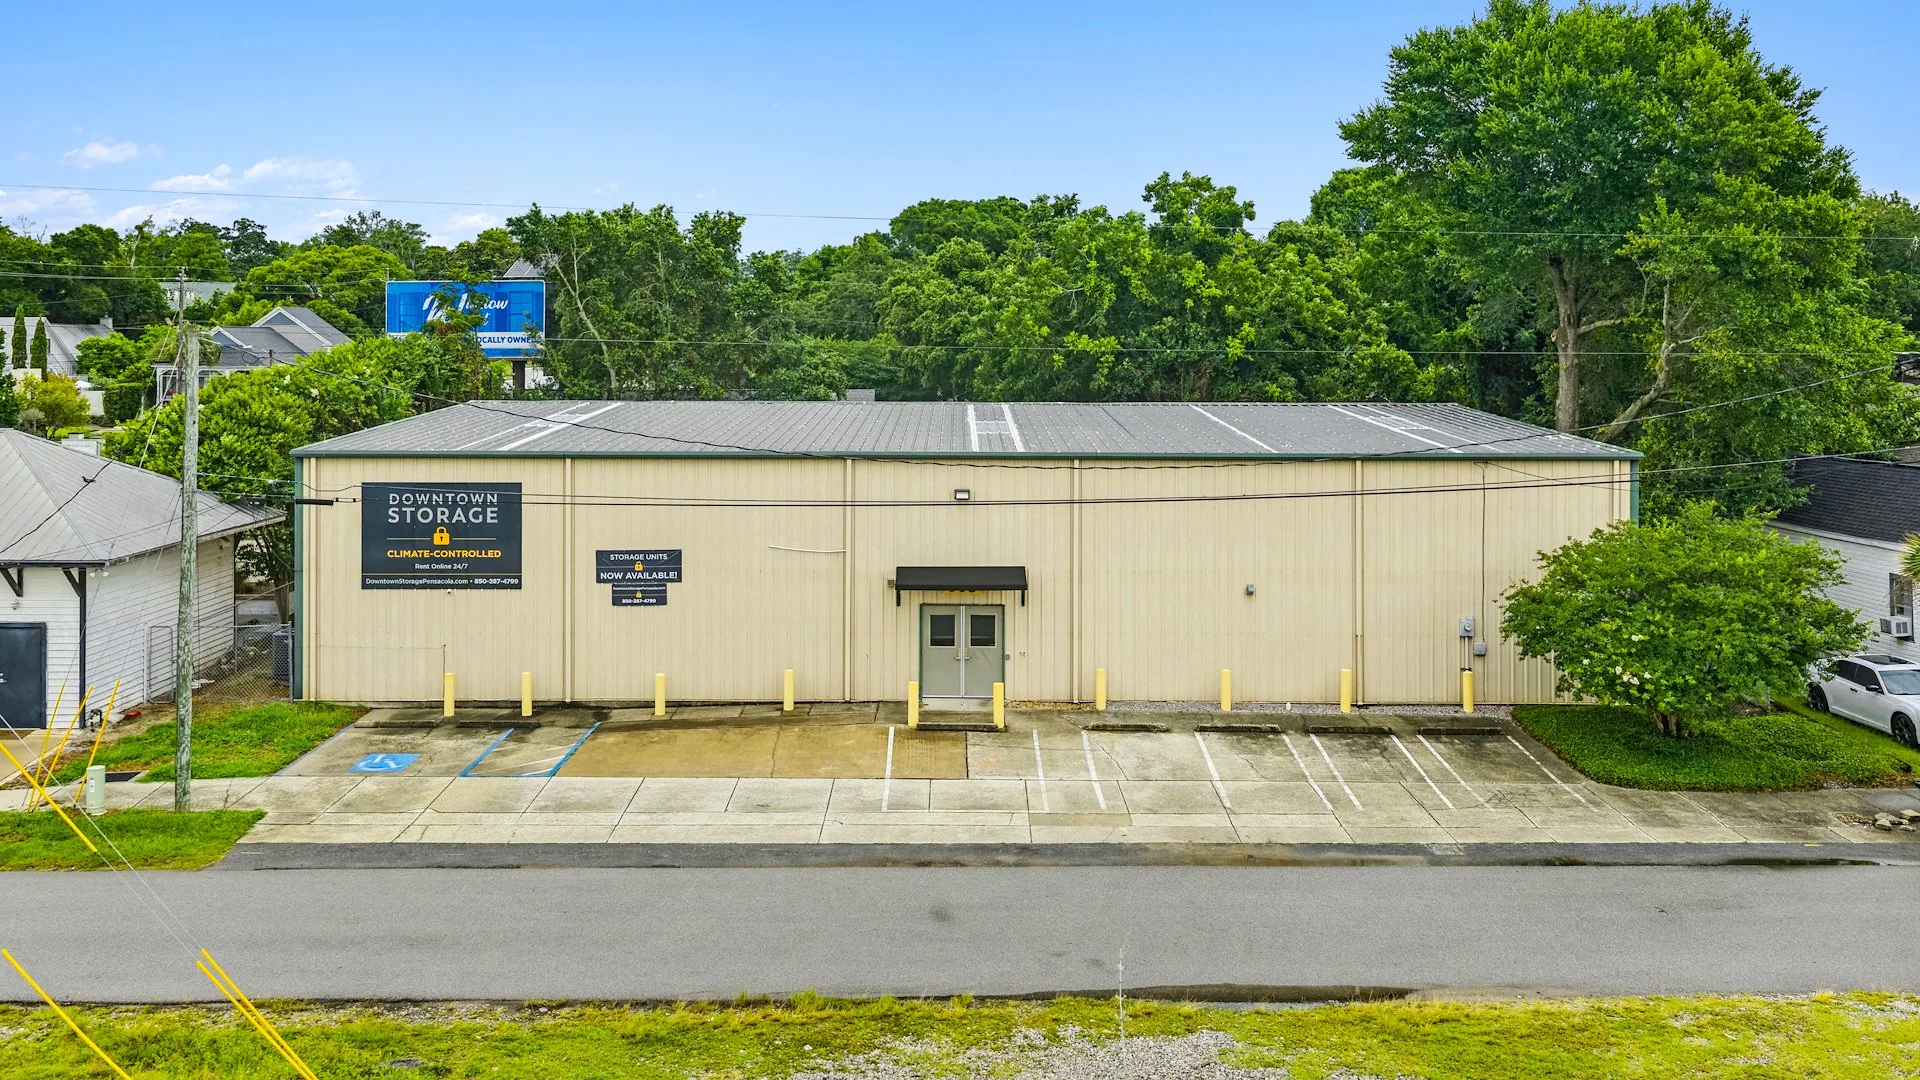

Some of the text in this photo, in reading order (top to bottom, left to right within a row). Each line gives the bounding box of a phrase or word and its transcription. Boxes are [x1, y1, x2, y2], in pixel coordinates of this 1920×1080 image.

[389, 493, 498, 505] DOWNTOWN
[388, 507, 498, 524] STORAGE
[387, 550, 501, 558] CLIMATE-CONTROLLED
[474, 577, 519, 585] 850-287-4799
